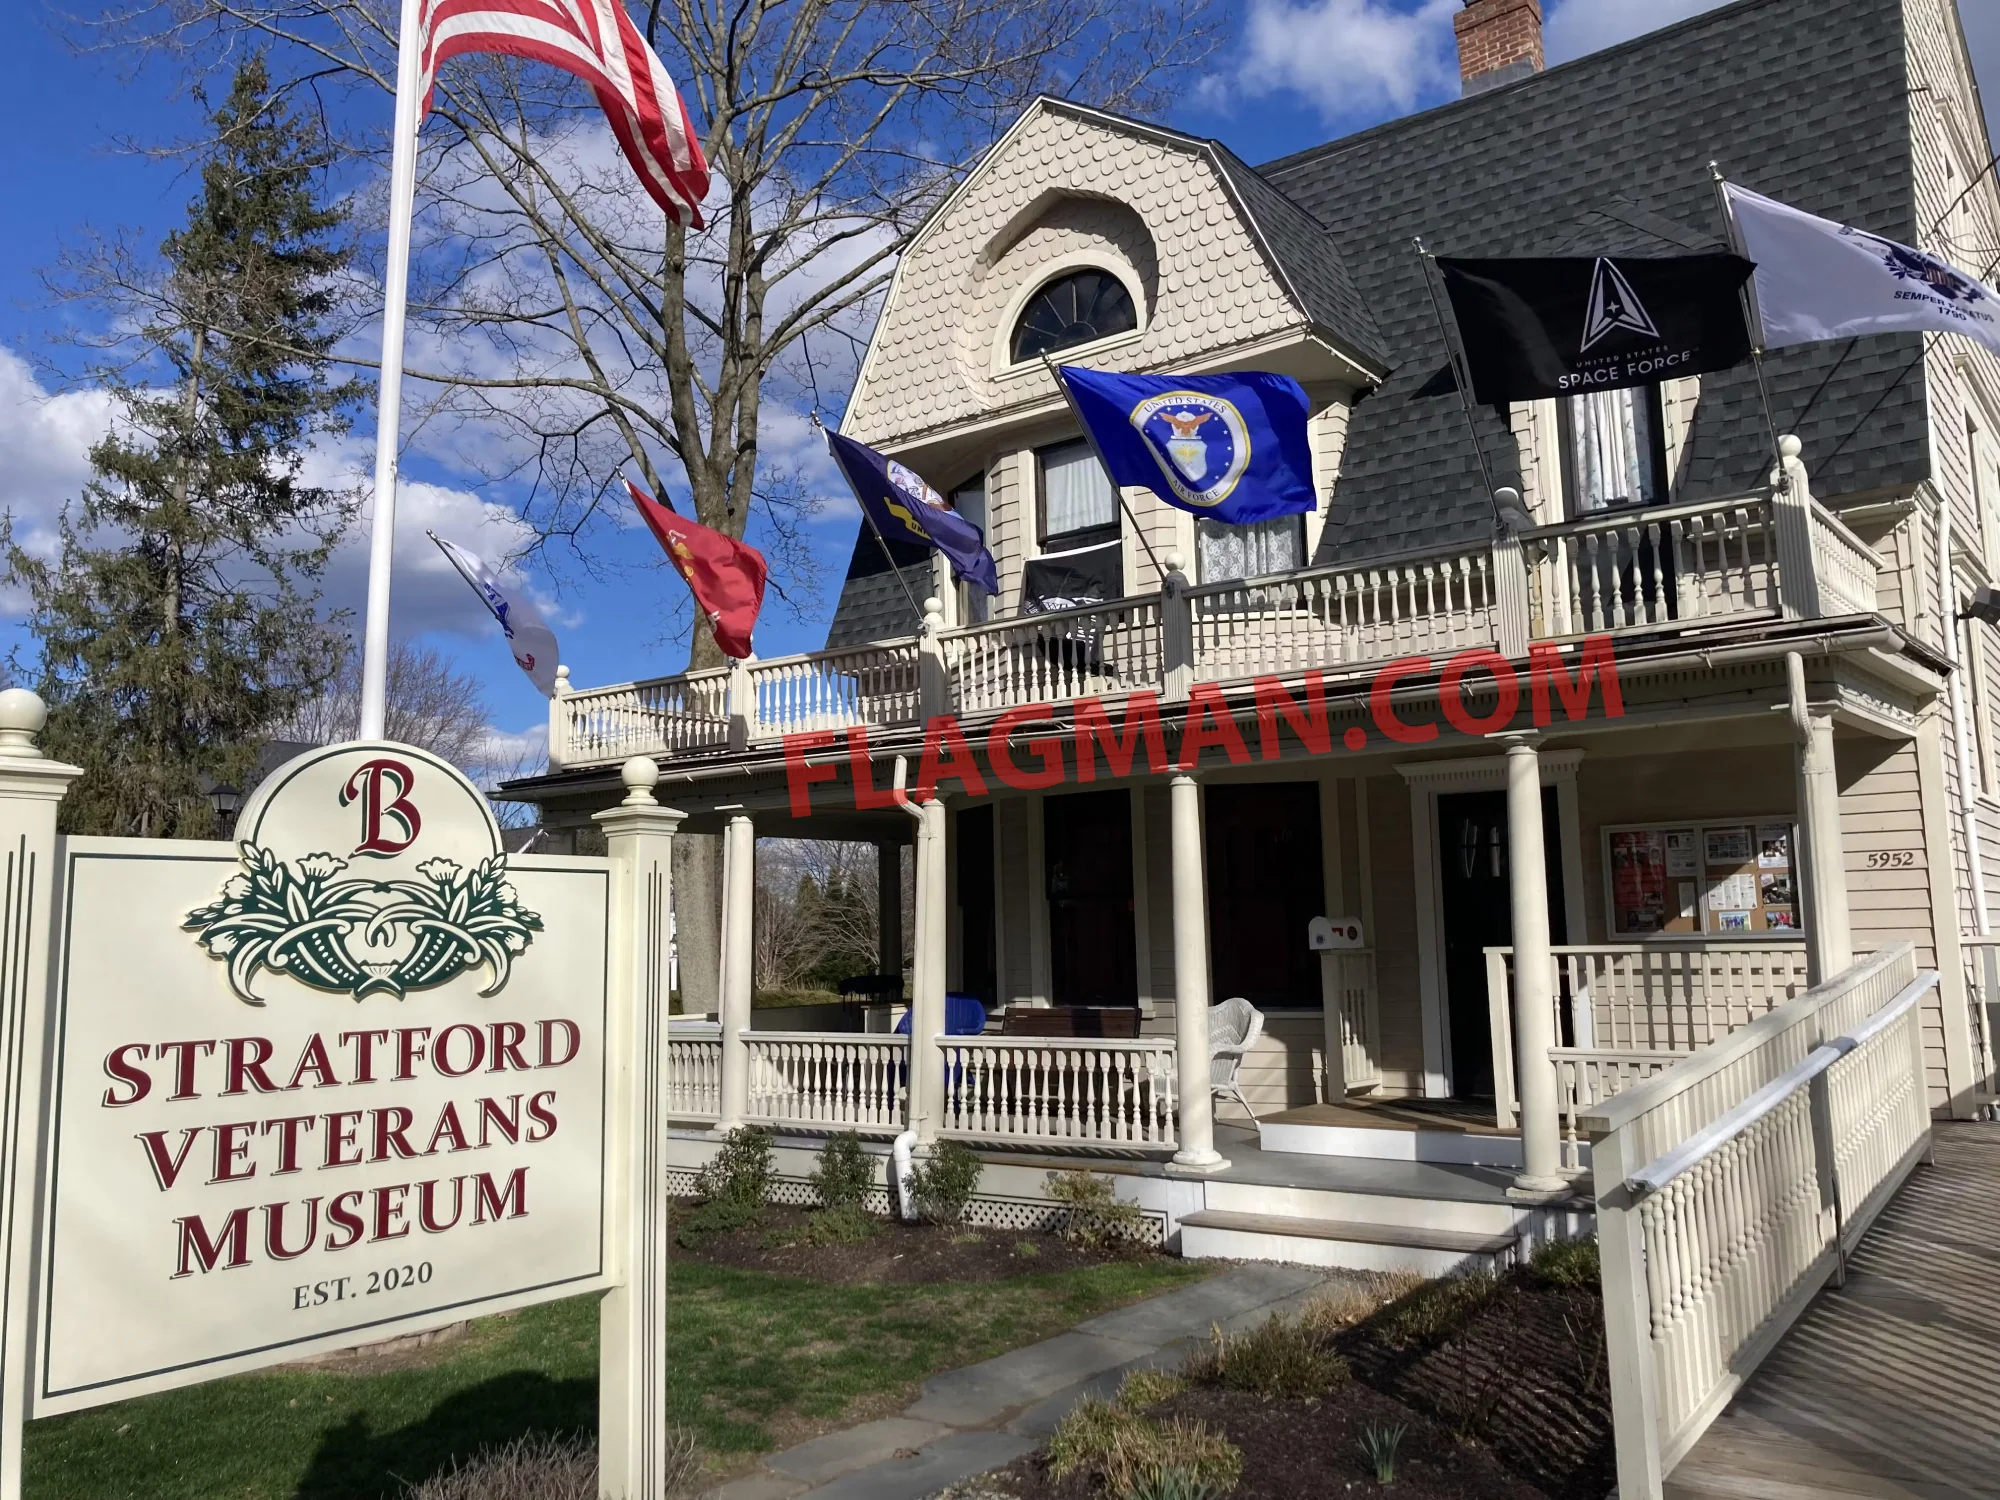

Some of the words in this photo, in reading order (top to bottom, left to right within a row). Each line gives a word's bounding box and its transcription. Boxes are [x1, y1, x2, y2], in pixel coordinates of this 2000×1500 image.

[1893, 290, 1945, 306] SEMPER
[1938, 306, 1967, 321] 1790
[1558, 366, 1619, 389] SPACE
[1627, 350, 1691, 376] FORCE
[1576, 355, 1619, 368] UNITED
[1626, 345, 1669, 359] STATES
[1143, 396, 1183, 413] UNITED
[1186, 396, 1227, 414] STATES
[1172, 479, 1185, 496] AIR
[1187, 488, 1220, 502] FORCE
[339, 759, 421, 858] B
[1866, 851, 1914, 868] 5952
[101, 1018, 582, 1109] STRATFORD
[134, 1090, 559, 1192] VETERANS
[170, 1166, 531, 1281] MUSEUM
[292, 1275, 357, 1311] EST.
[366, 1261, 433, 1297] 2020
